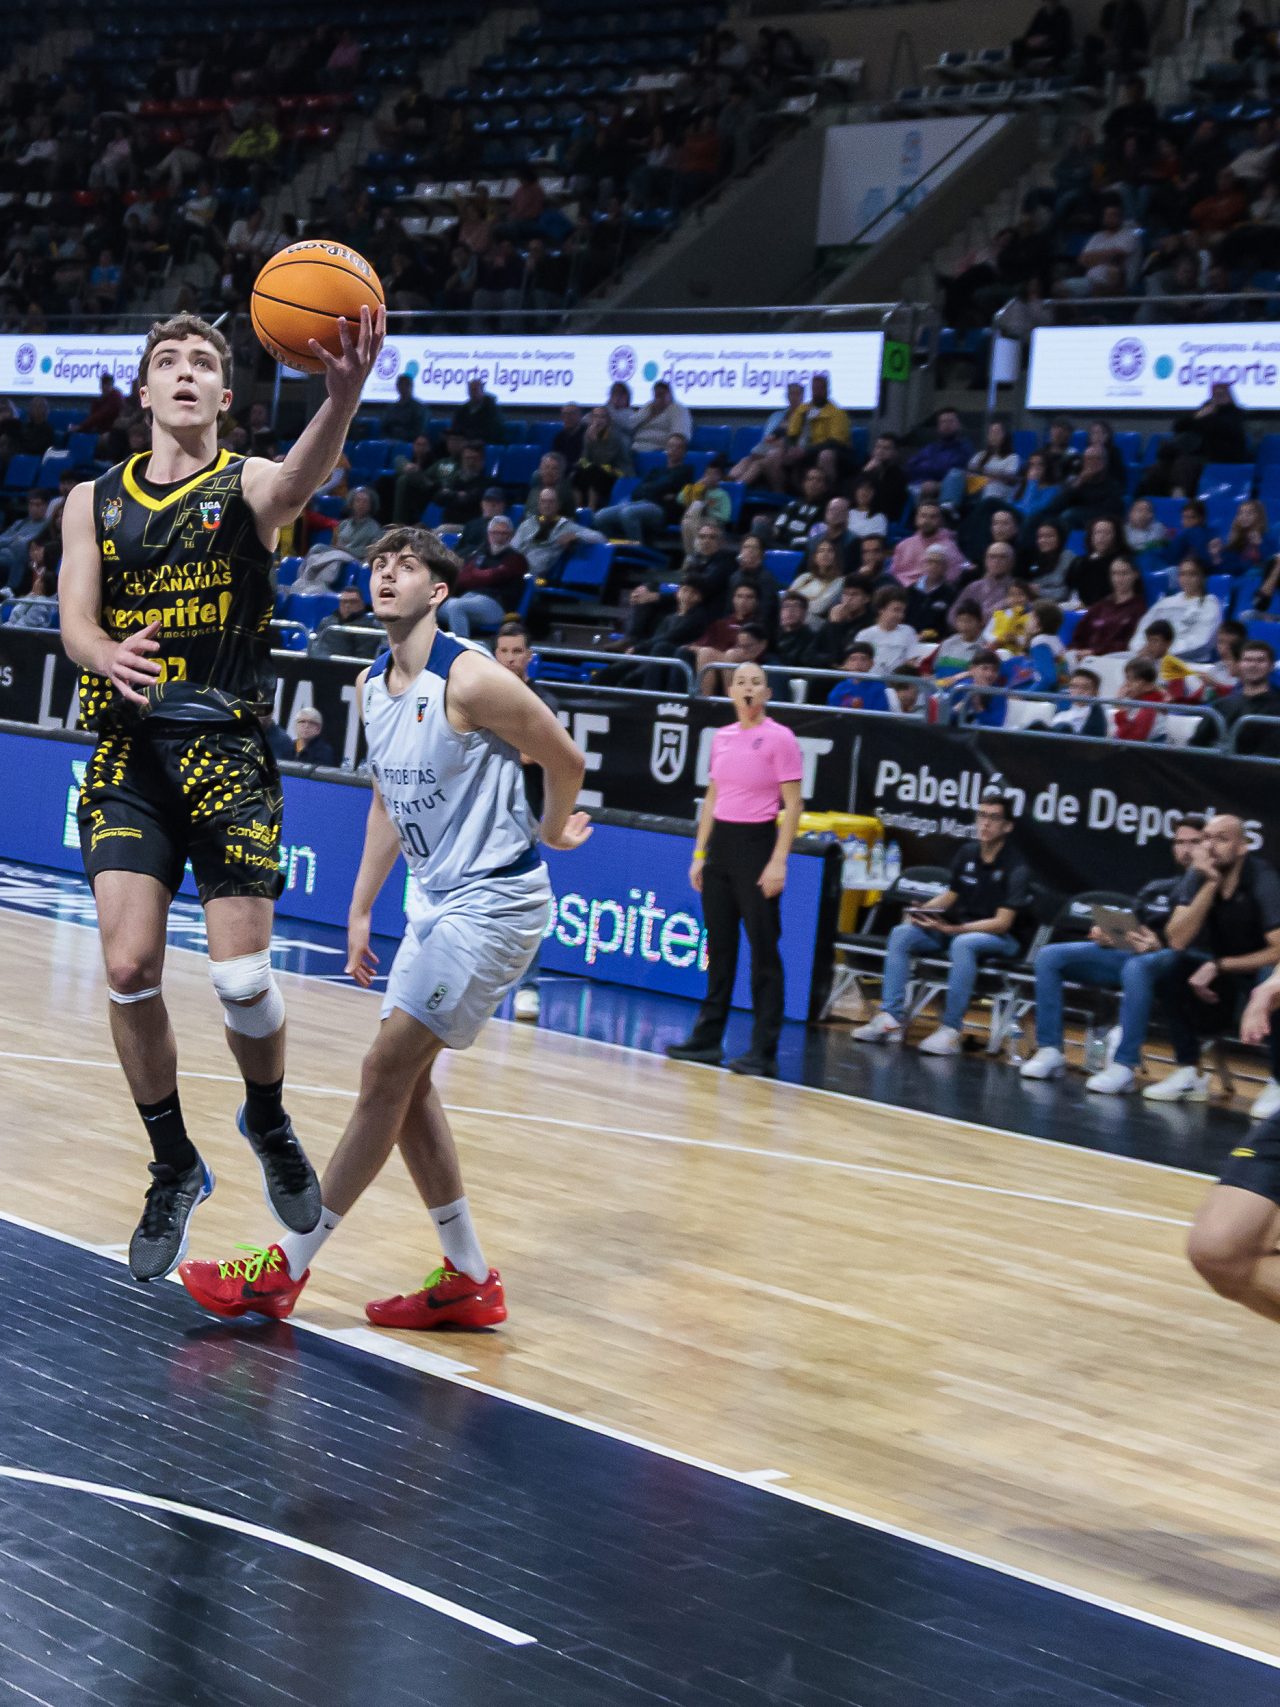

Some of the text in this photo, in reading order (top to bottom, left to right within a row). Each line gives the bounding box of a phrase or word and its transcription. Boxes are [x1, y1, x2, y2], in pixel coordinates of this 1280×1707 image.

[422, 361, 573, 392] deporte lagunero
[662, 362, 736, 393] deporte
[1178, 355, 1277, 386] deporte
[199, 501, 222, 510] LIGA
[148, 571, 232, 593] CANARIAS
[384, 768, 436, 785] PROBITAS
[1032, 783, 1080, 825] de
